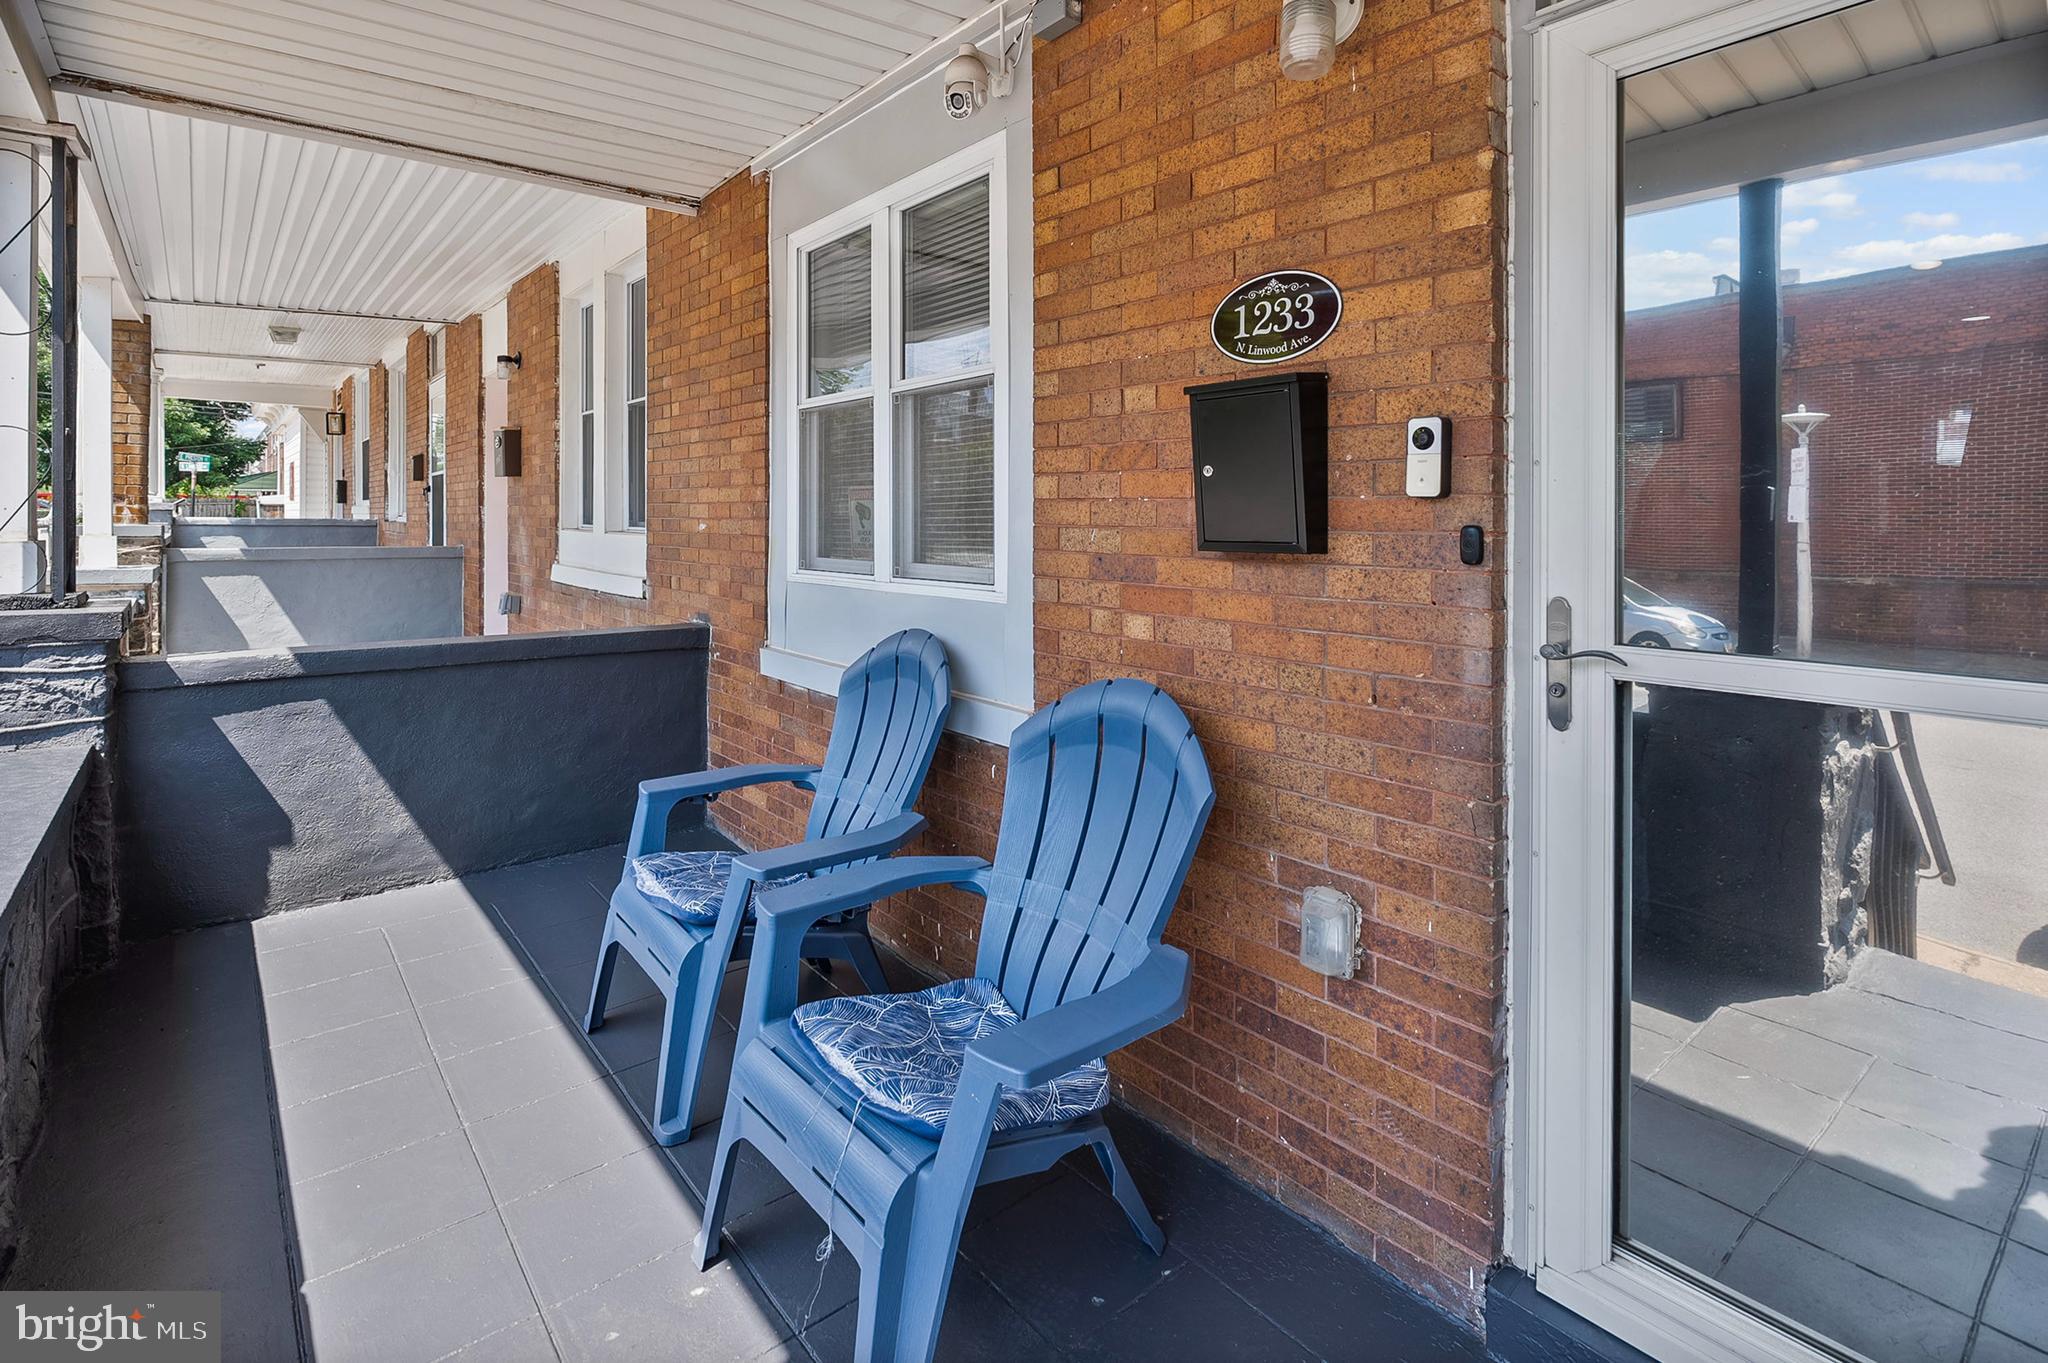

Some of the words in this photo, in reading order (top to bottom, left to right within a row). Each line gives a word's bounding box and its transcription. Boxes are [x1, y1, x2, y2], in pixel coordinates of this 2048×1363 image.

[1234, 293, 1315, 339] 1233
[1236, 342, 1246, 353] N.
[1248, 342, 1287, 355] Linwood
[1290, 335, 1311, 349] Ave.
